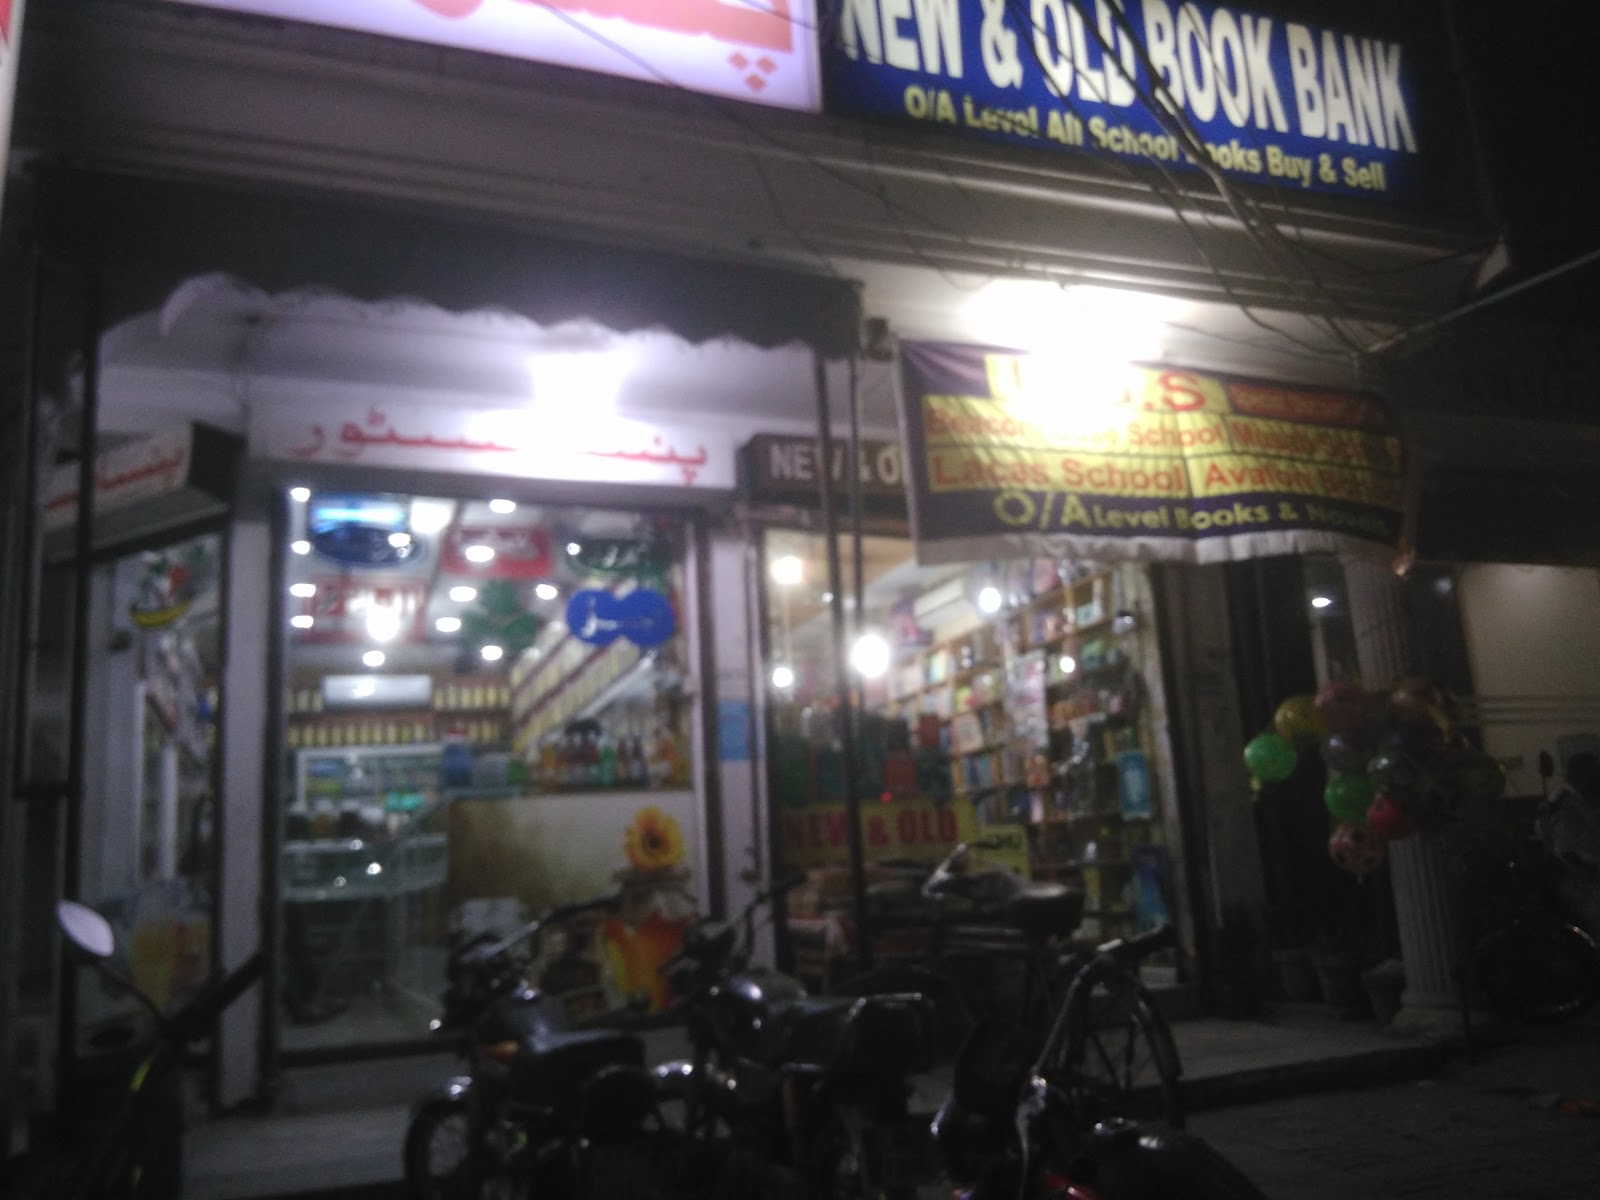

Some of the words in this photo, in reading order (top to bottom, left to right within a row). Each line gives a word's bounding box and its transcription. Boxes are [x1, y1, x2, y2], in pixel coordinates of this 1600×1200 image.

[840, 0, 963, 78] NEW
[981, 0, 1023, 90] &
[1030, 0, 1137, 107] OLD
[1142, 0, 1289, 133] BOOK
[1287, 22, 1418, 154] BANK
[903, 84, 957, 124] O/A
[963, 96, 1040, 139] Level
[1046, 109, 1084, 147] All
[1088, 116, 1180, 162] School
[1265, 145, 1313, 188] Buy
[1319, 153, 1338, 185] &
[1342, 157, 1388, 192] Sell
[1128, 419, 1225, 447] School
[1061, 457, 1187, 491] School
[1093, 505, 1169, 529] Level
[1172, 502, 1270, 530] Books
[897, 808, 958, 844] OLD
